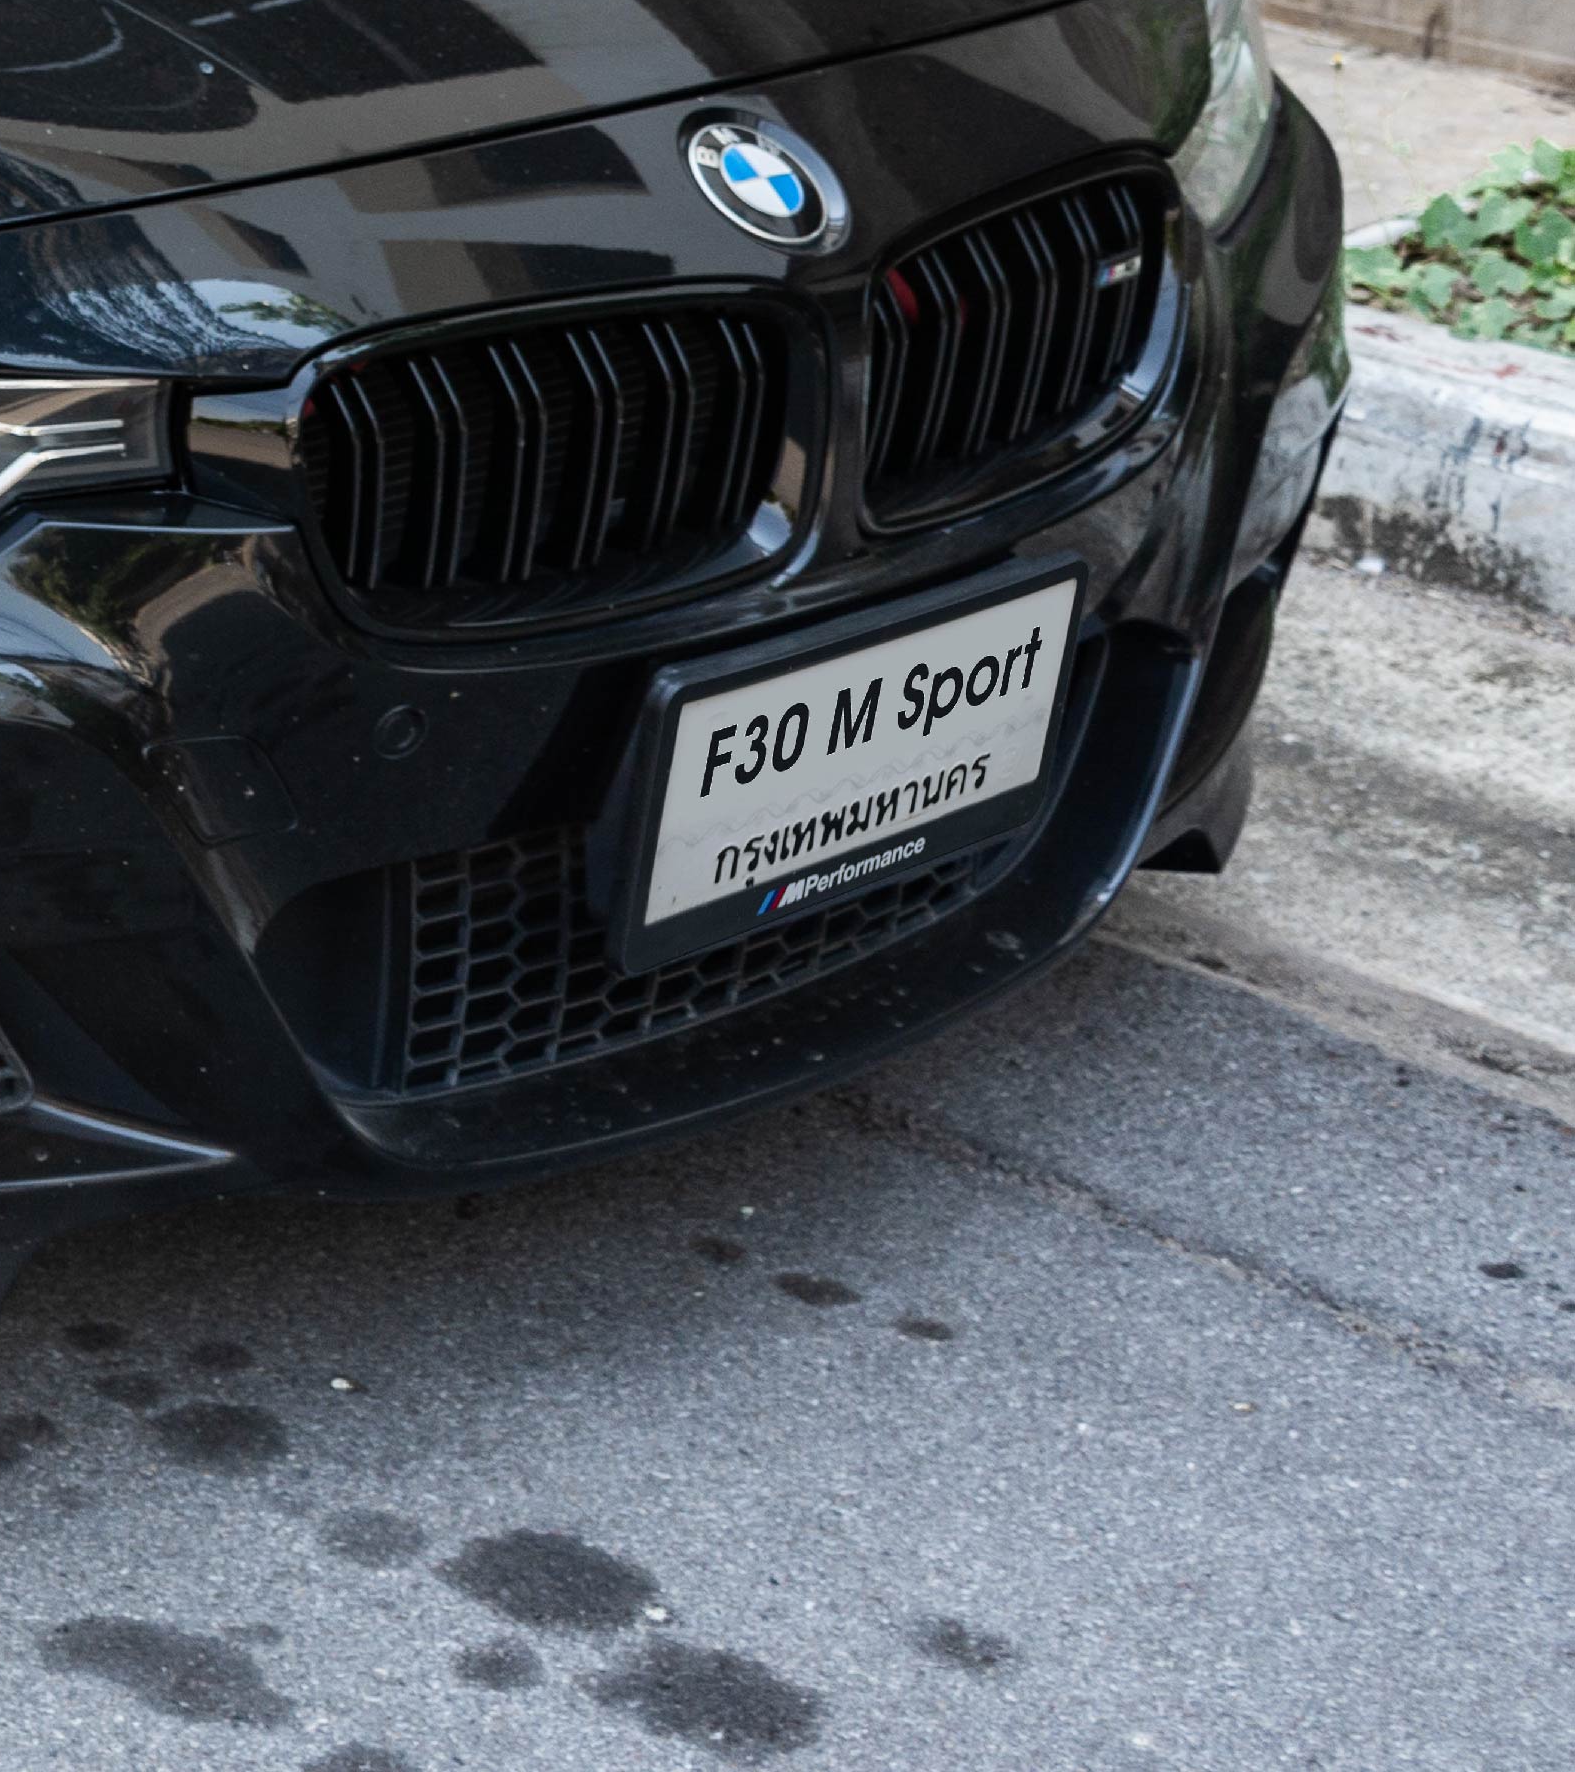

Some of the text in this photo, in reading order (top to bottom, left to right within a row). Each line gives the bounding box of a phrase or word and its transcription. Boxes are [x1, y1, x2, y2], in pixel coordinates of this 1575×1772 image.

[700, 626, 1043, 798] F30 M Sport
[713, 752, 992, 888] กรุงเทพมหานคร
